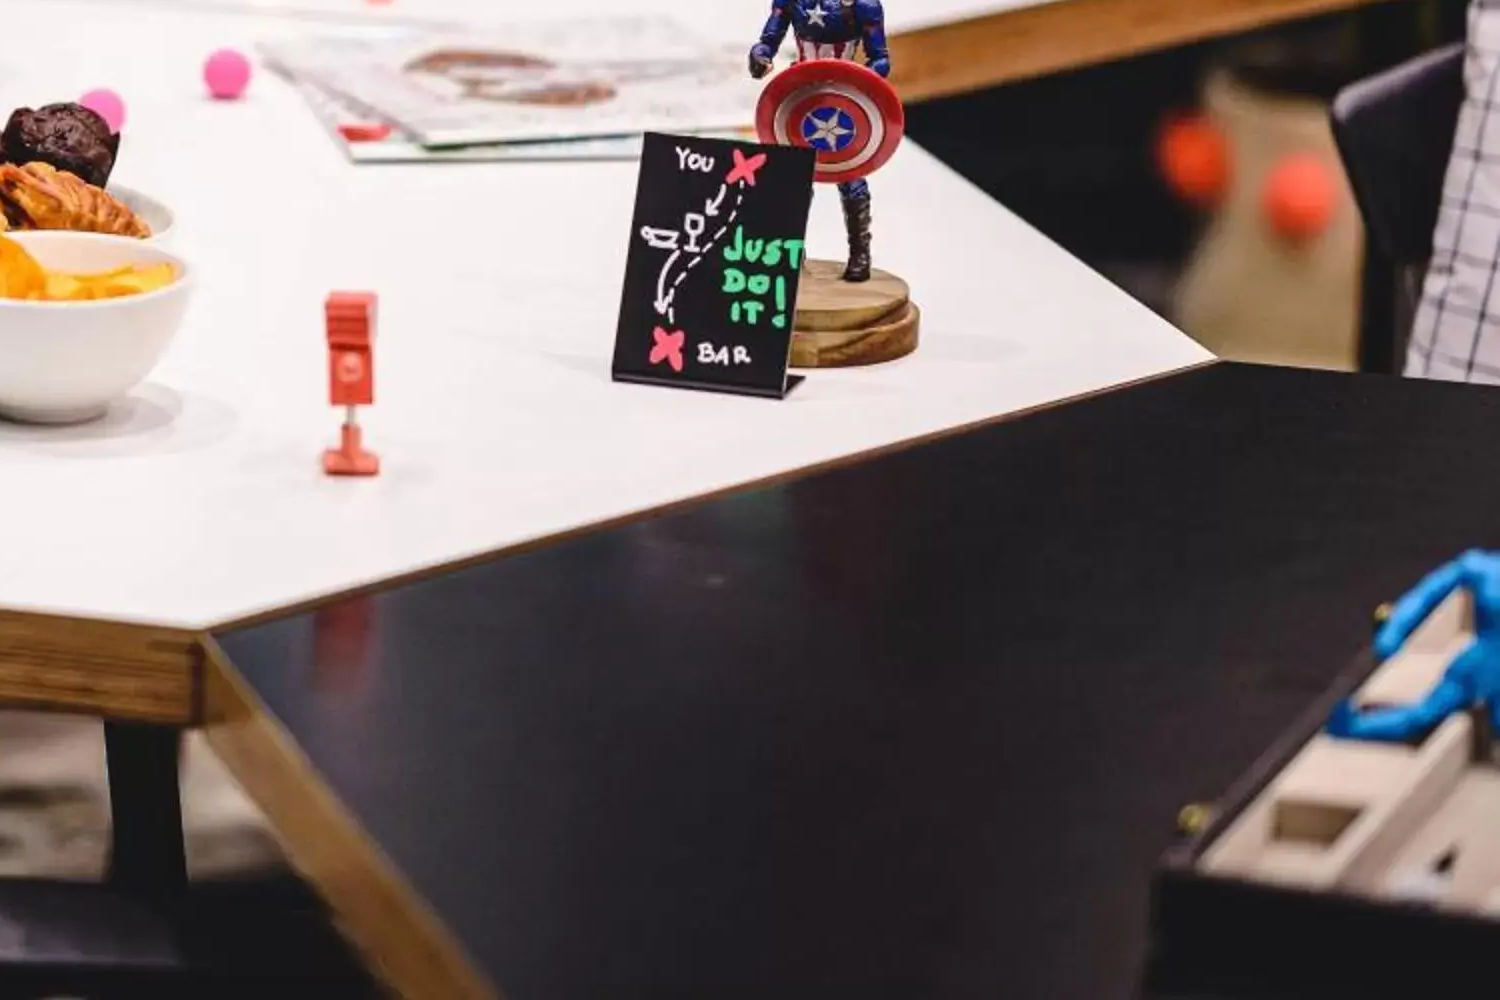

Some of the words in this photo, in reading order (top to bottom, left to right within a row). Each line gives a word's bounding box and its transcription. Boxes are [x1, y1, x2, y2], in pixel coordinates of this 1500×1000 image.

[676, 147, 715, 172] YOU
[723, 225, 804, 269] JUST
[722, 268, 770, 295] DO
[697, 342, 751, 365] BAR
